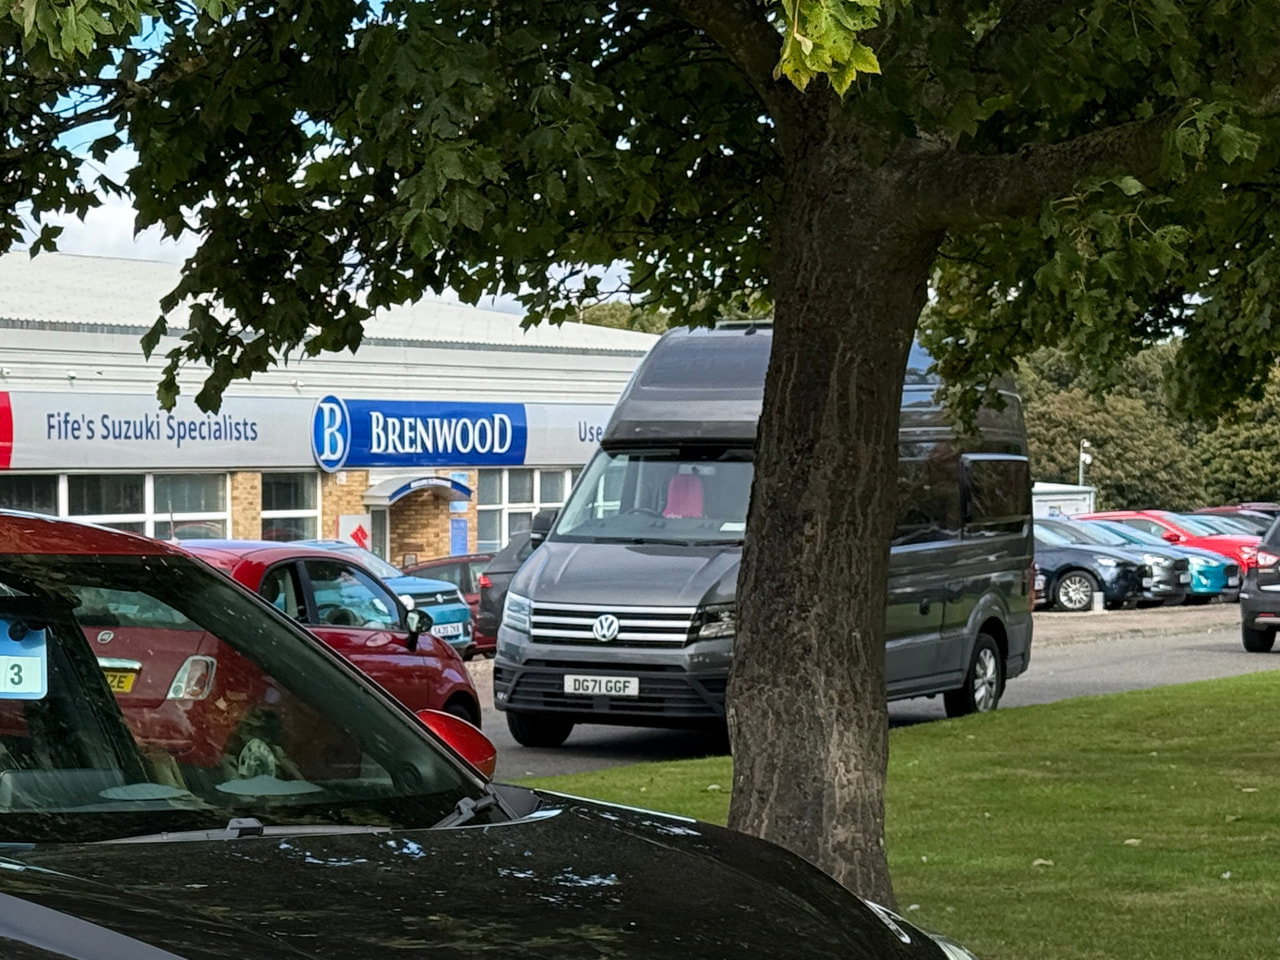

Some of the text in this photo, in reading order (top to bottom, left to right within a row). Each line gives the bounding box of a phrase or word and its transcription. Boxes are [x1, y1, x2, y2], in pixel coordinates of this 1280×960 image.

[46, 412, 258, 448] Fife's Suzuki Specialists
[369, 411, 513, 454] BRENWOOD
[10, 663, 24, 685] 3
[106, 673, 128, 689] ZE
[573, 678, 631, 693] DG71 GGF
